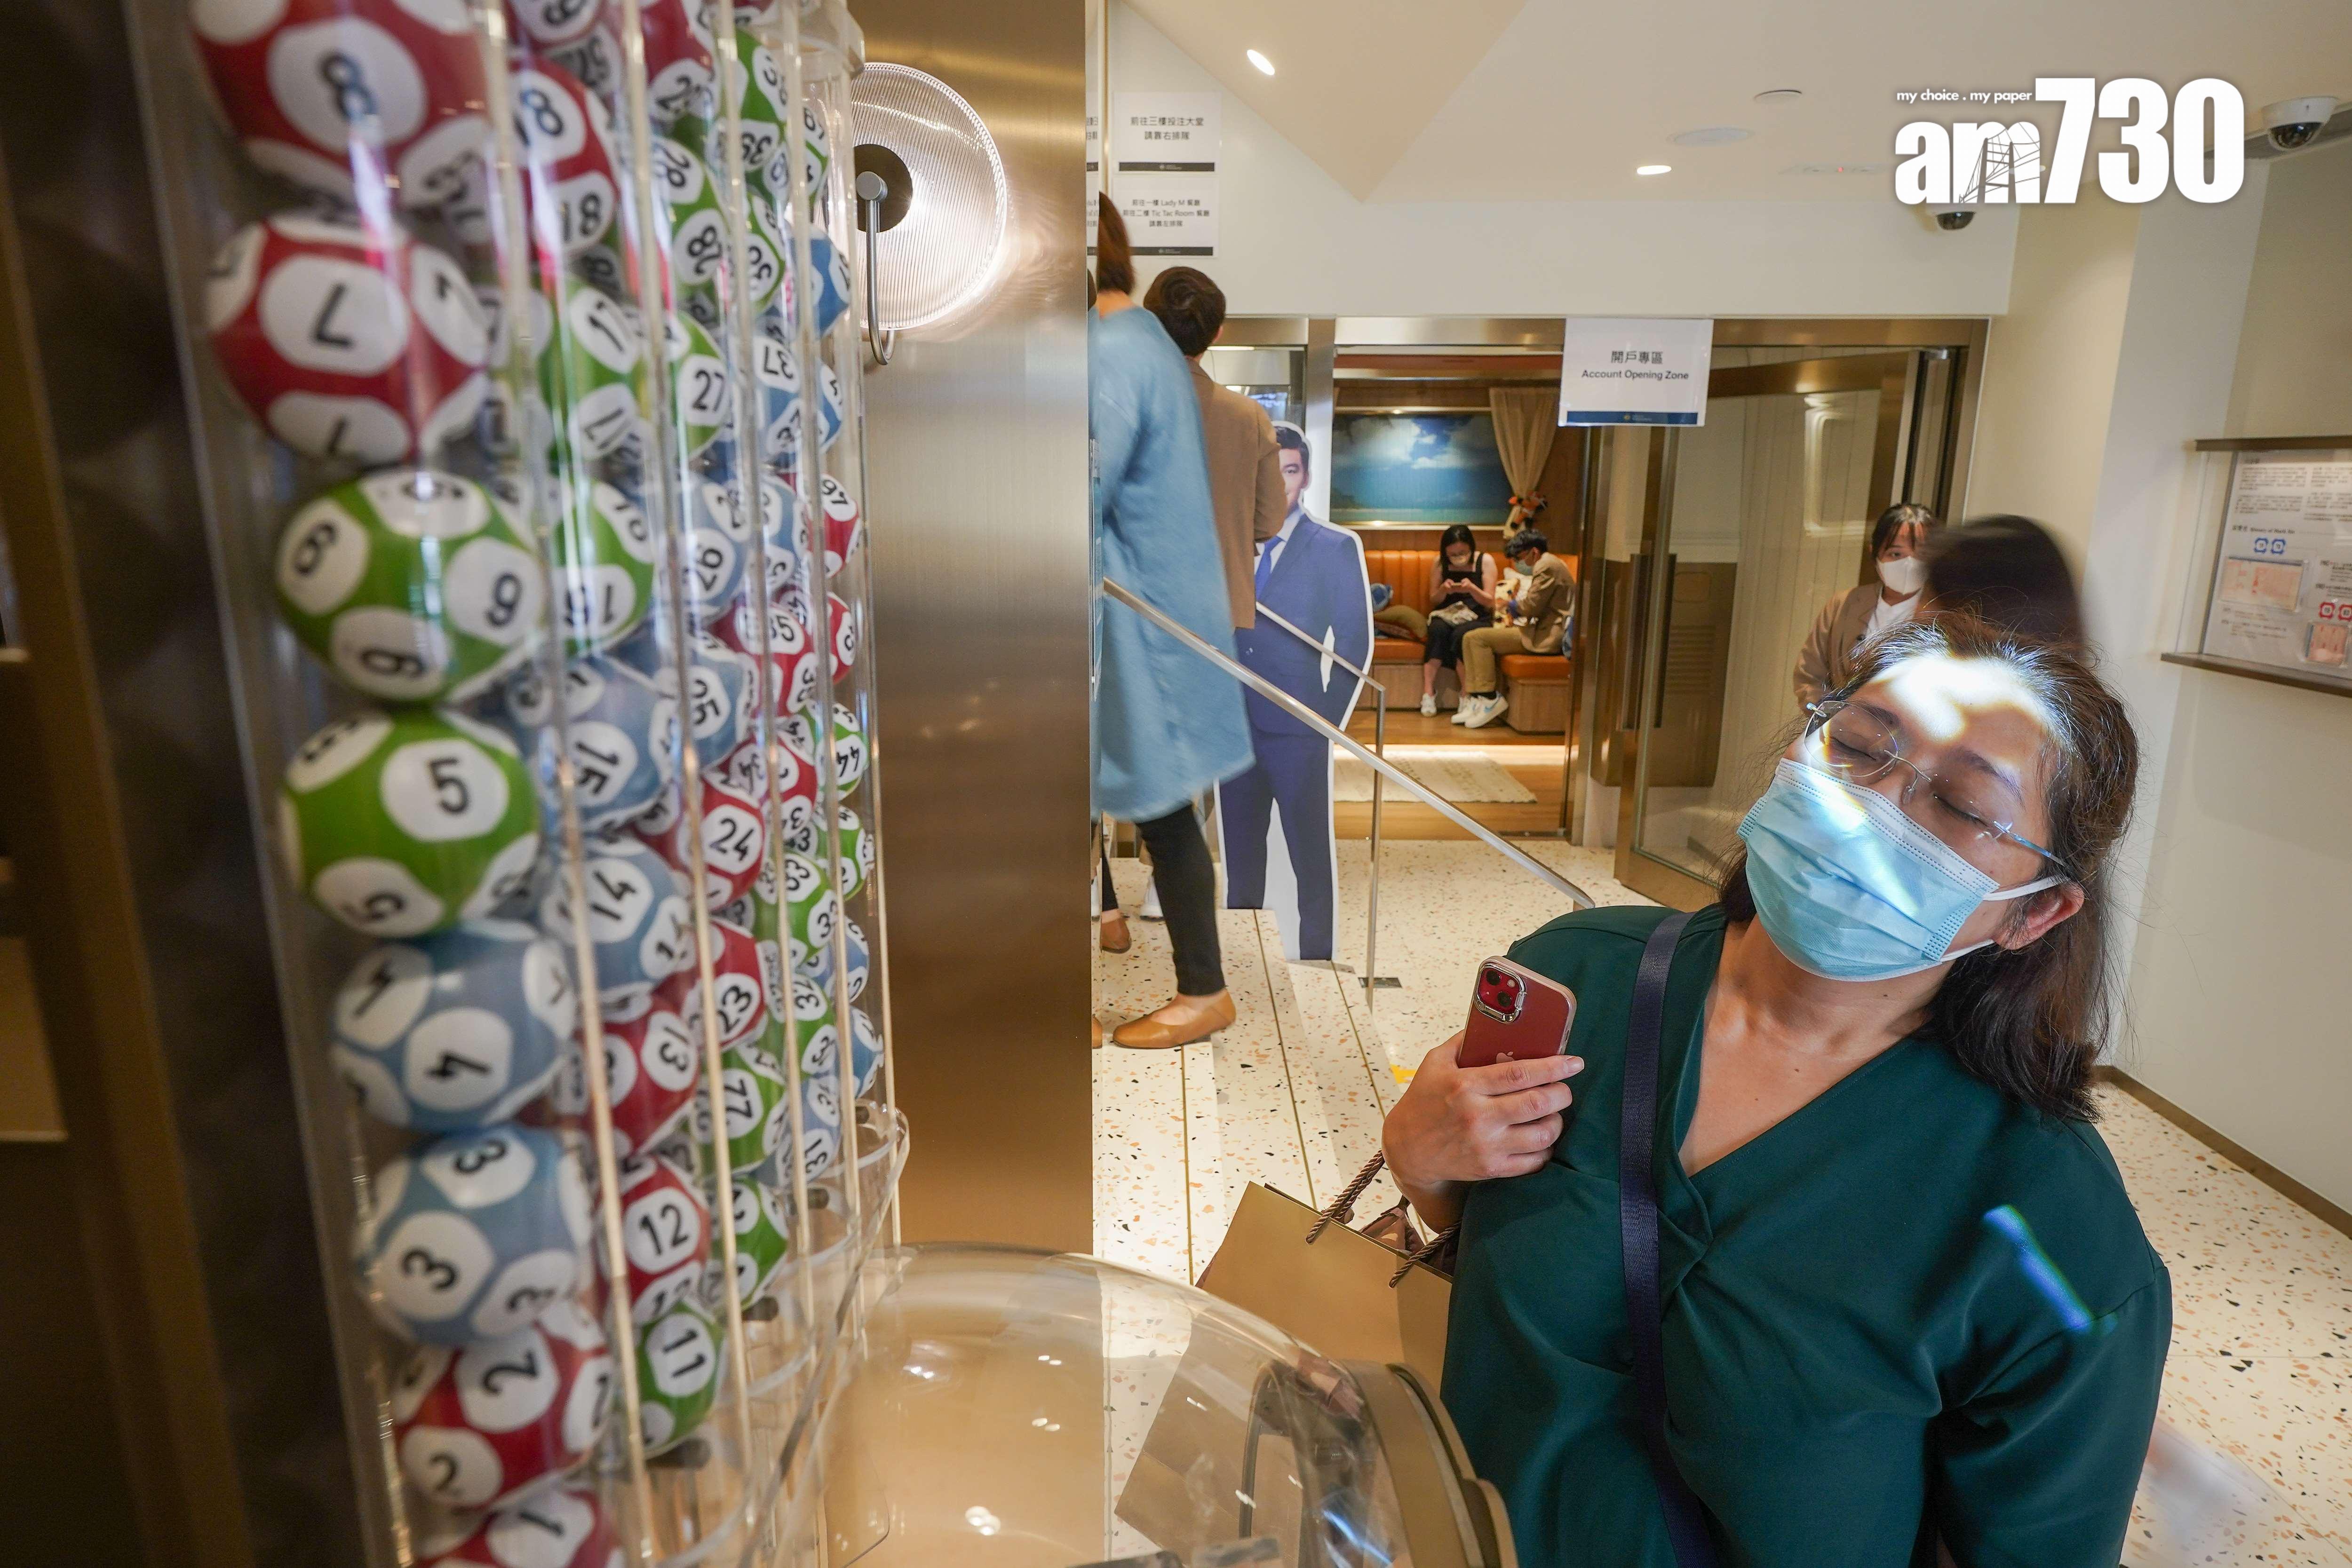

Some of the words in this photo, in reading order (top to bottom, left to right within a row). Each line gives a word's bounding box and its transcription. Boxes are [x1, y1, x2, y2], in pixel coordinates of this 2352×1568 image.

[320, 50, 377, 121] 8
[687, 225, 723, 276] 28
[312, 282, 353, 349] 7
[764, 346, 794, 379] 37
[1581, 370, 1622, 378] Account
[1625, 370, 1662, 380] Opening
[692, 369, 725, 412] 27
[429, 757, 469, 814] 5
[575, 741, 621, 795] 15
[836, 746, 860, 778] 44
[709, 817, 755, 863] 24
[590, 869, 636, 922] 14
[785, 859, 811, 891] 33
[718, 984, 752, 1034] 23
[659, 1025, 689, 1073] 13
[455, 1138, 508, 1175] 3
[804, 1138, 828, 1174] 31
[639, 1204, 690, 1256] 12
[402, 1247, 458, 1292] 3
[480, 1349, 541, 1397] 2
[663, 1329, 708, 1379] 11
